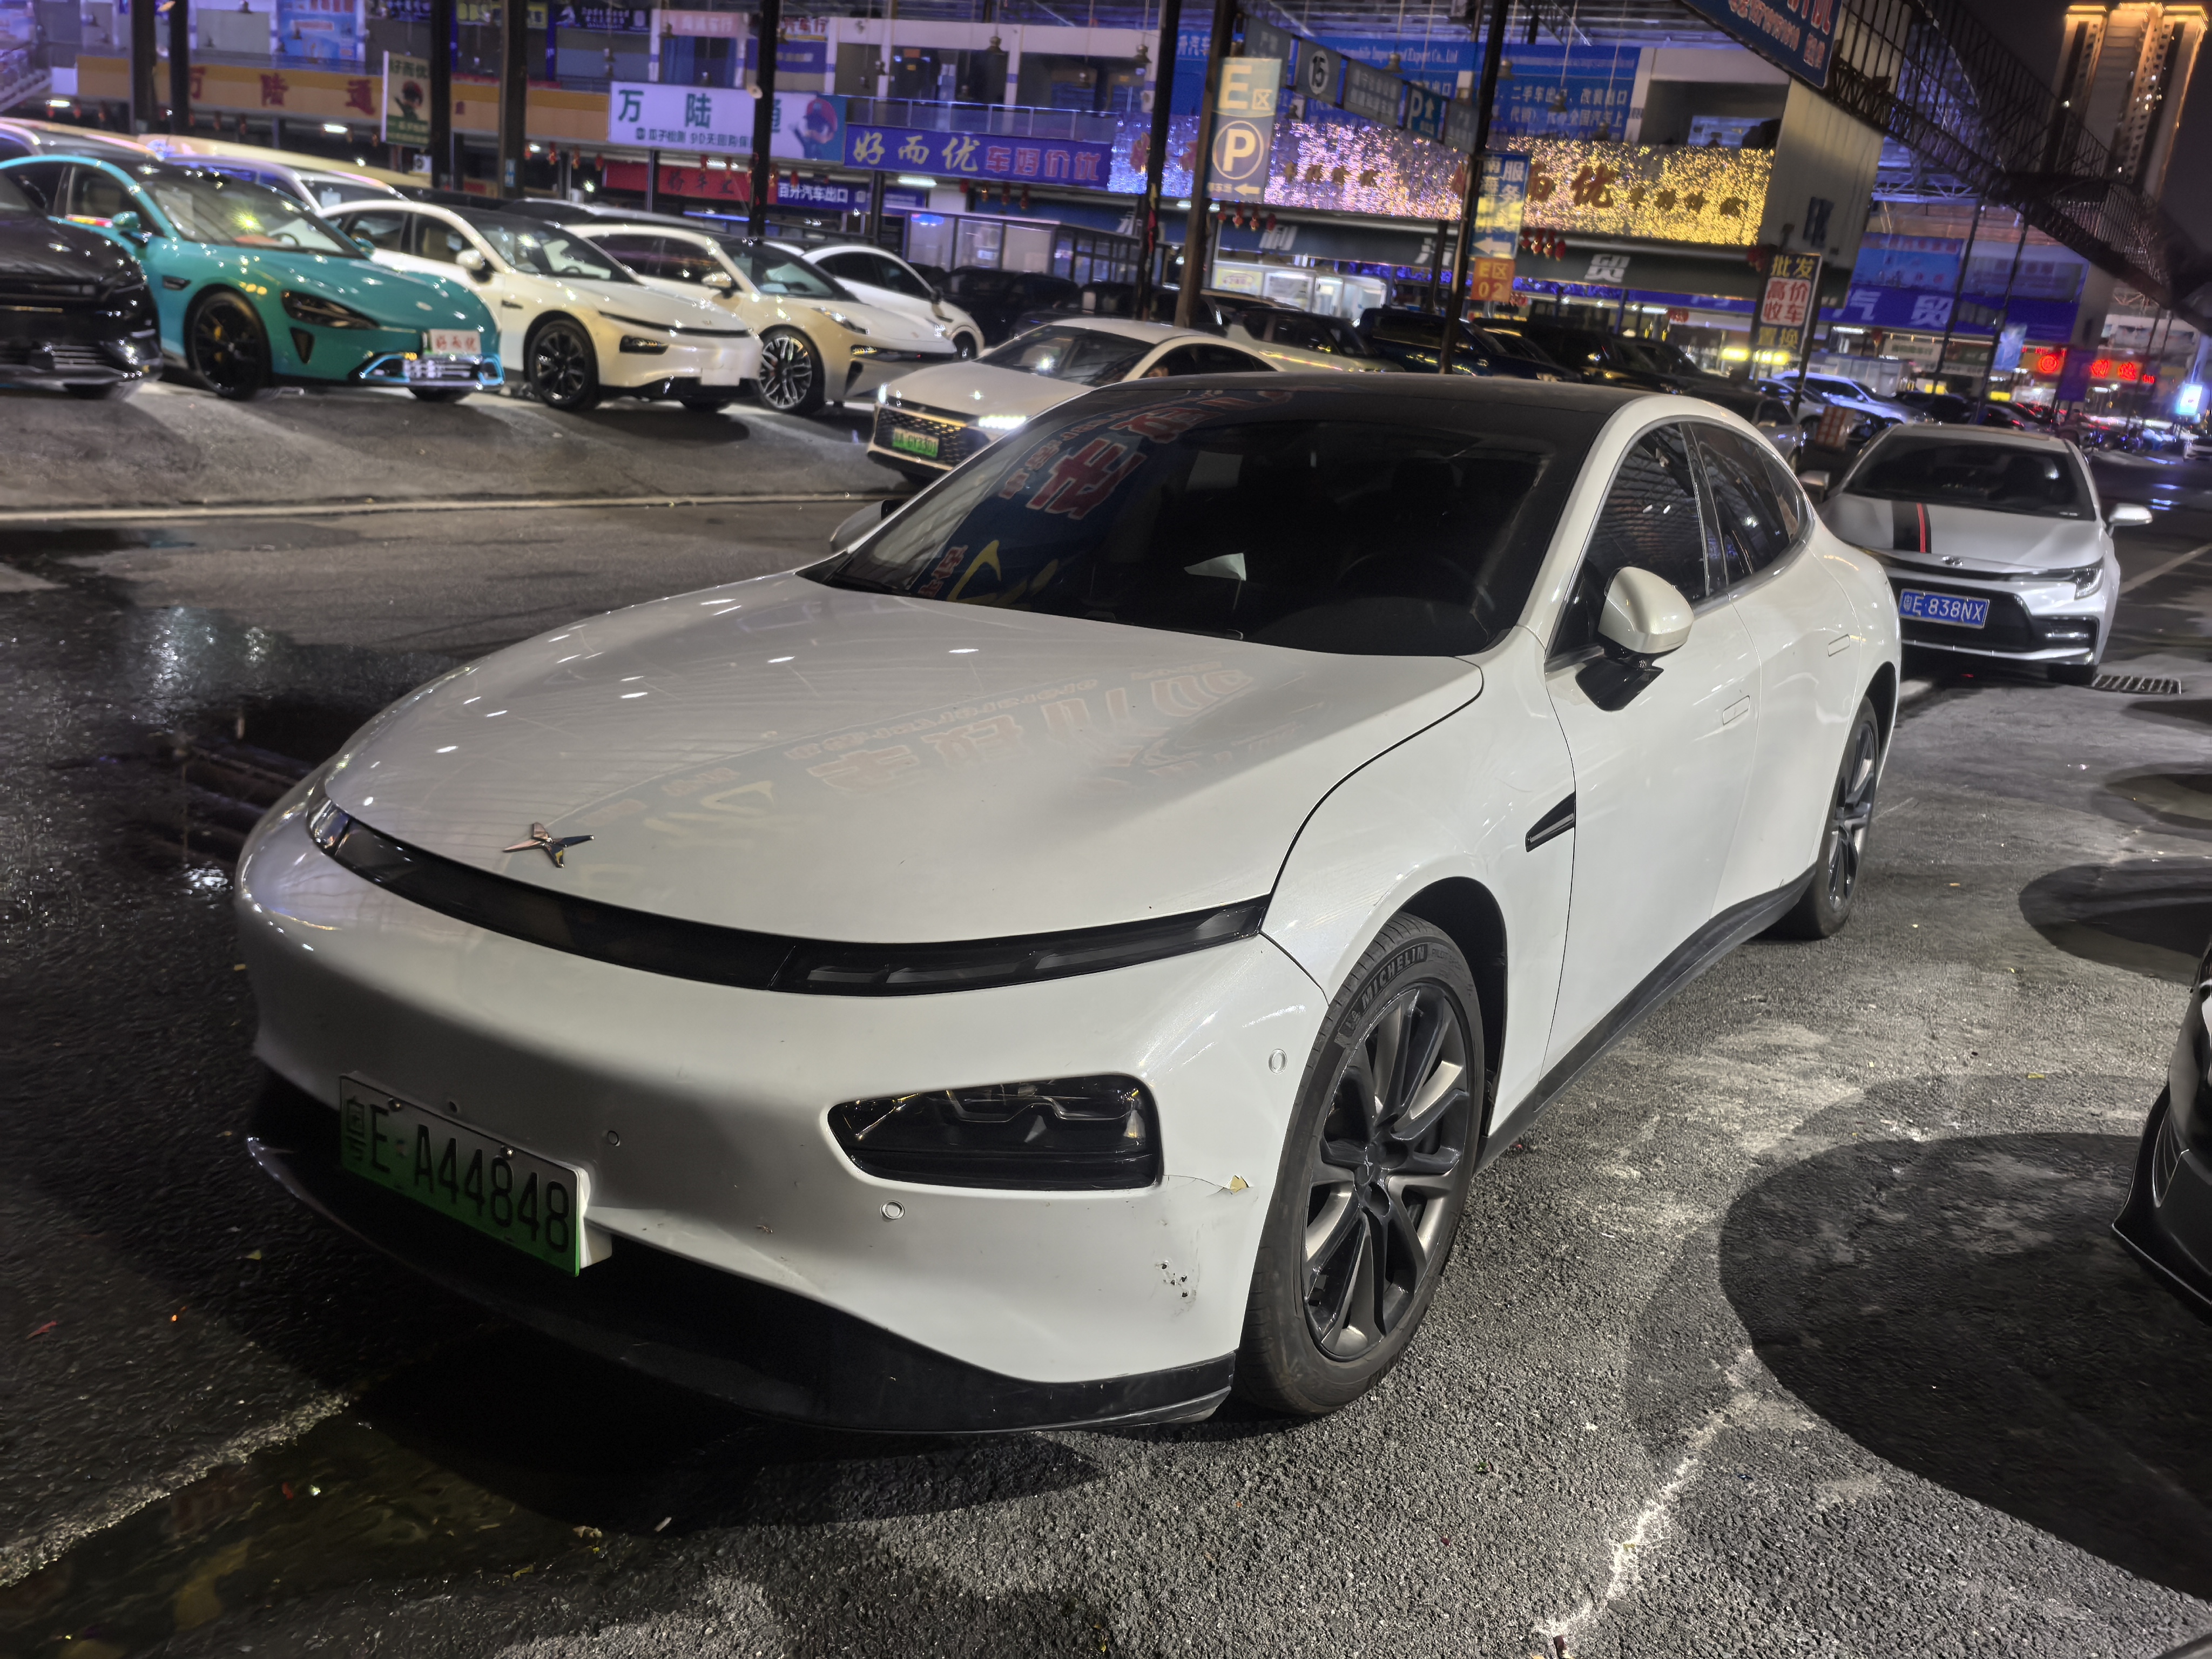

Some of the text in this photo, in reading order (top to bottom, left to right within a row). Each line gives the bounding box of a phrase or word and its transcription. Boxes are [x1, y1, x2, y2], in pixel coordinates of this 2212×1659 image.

[853, 131, 981, 172] 好而优
[985, 145, 1102, 181] 车好价优
[1222, 129, 1257, 172] P
[1477, 281, 1503, 299] 02
[1770, 255, 1815, 280] 批发
[1361, 945, 1425, 1010] MICHELIN
[414, 1124, 569, 1252] A44848
